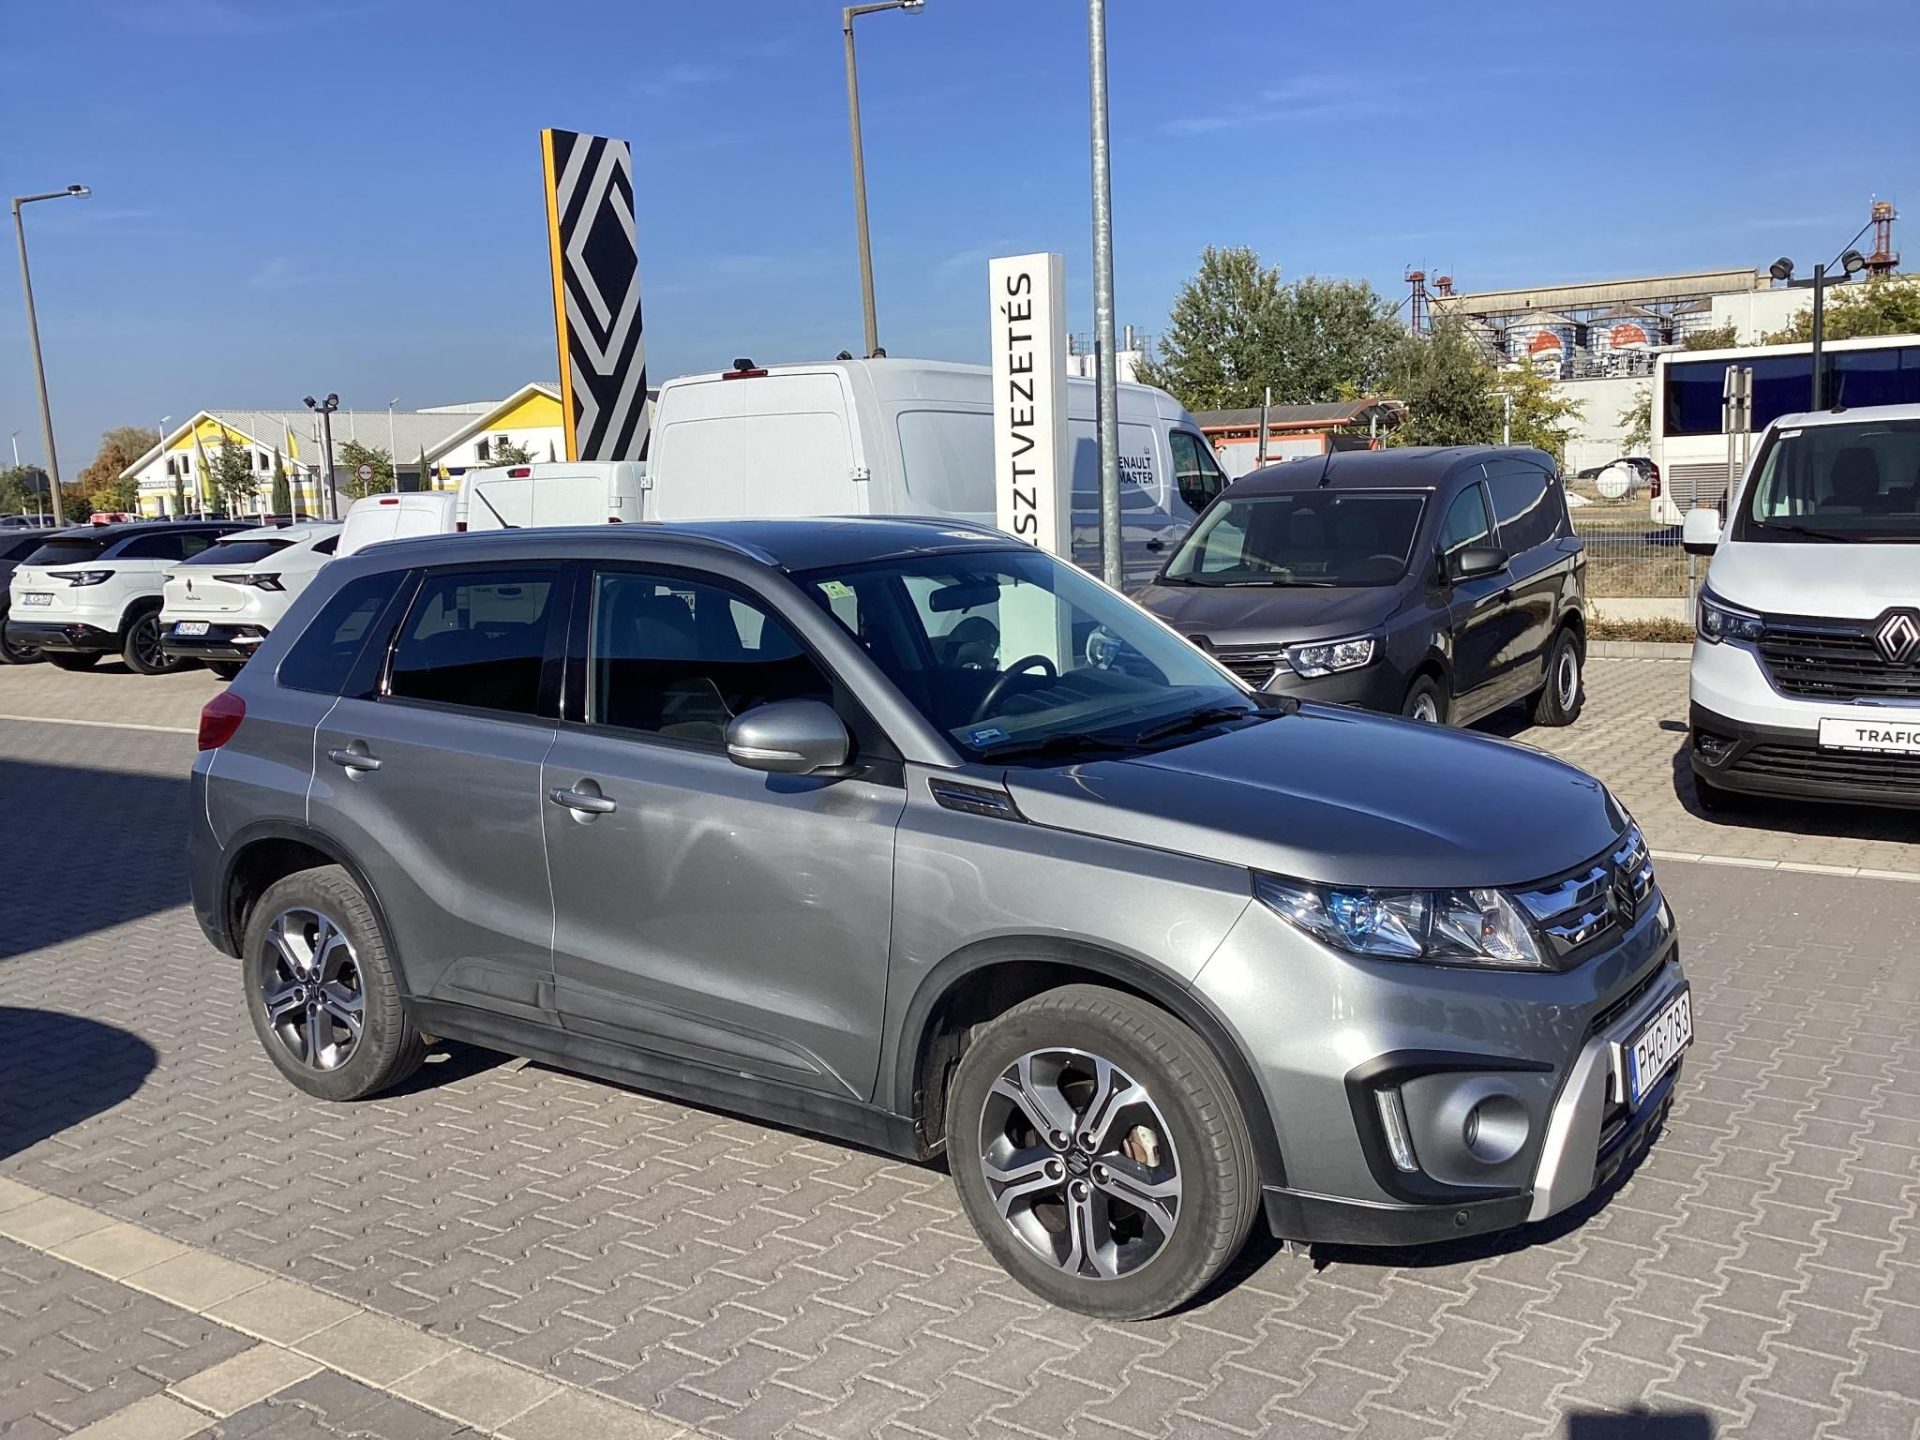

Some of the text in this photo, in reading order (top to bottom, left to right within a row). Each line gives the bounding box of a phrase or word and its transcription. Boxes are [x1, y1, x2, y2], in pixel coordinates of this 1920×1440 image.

[1000, 272, 1038, 547] SZTVEZETÉS
[1118, 456, 1151, 469] ENAULT
[1638, 999, 1688, 1087] PHG-783
